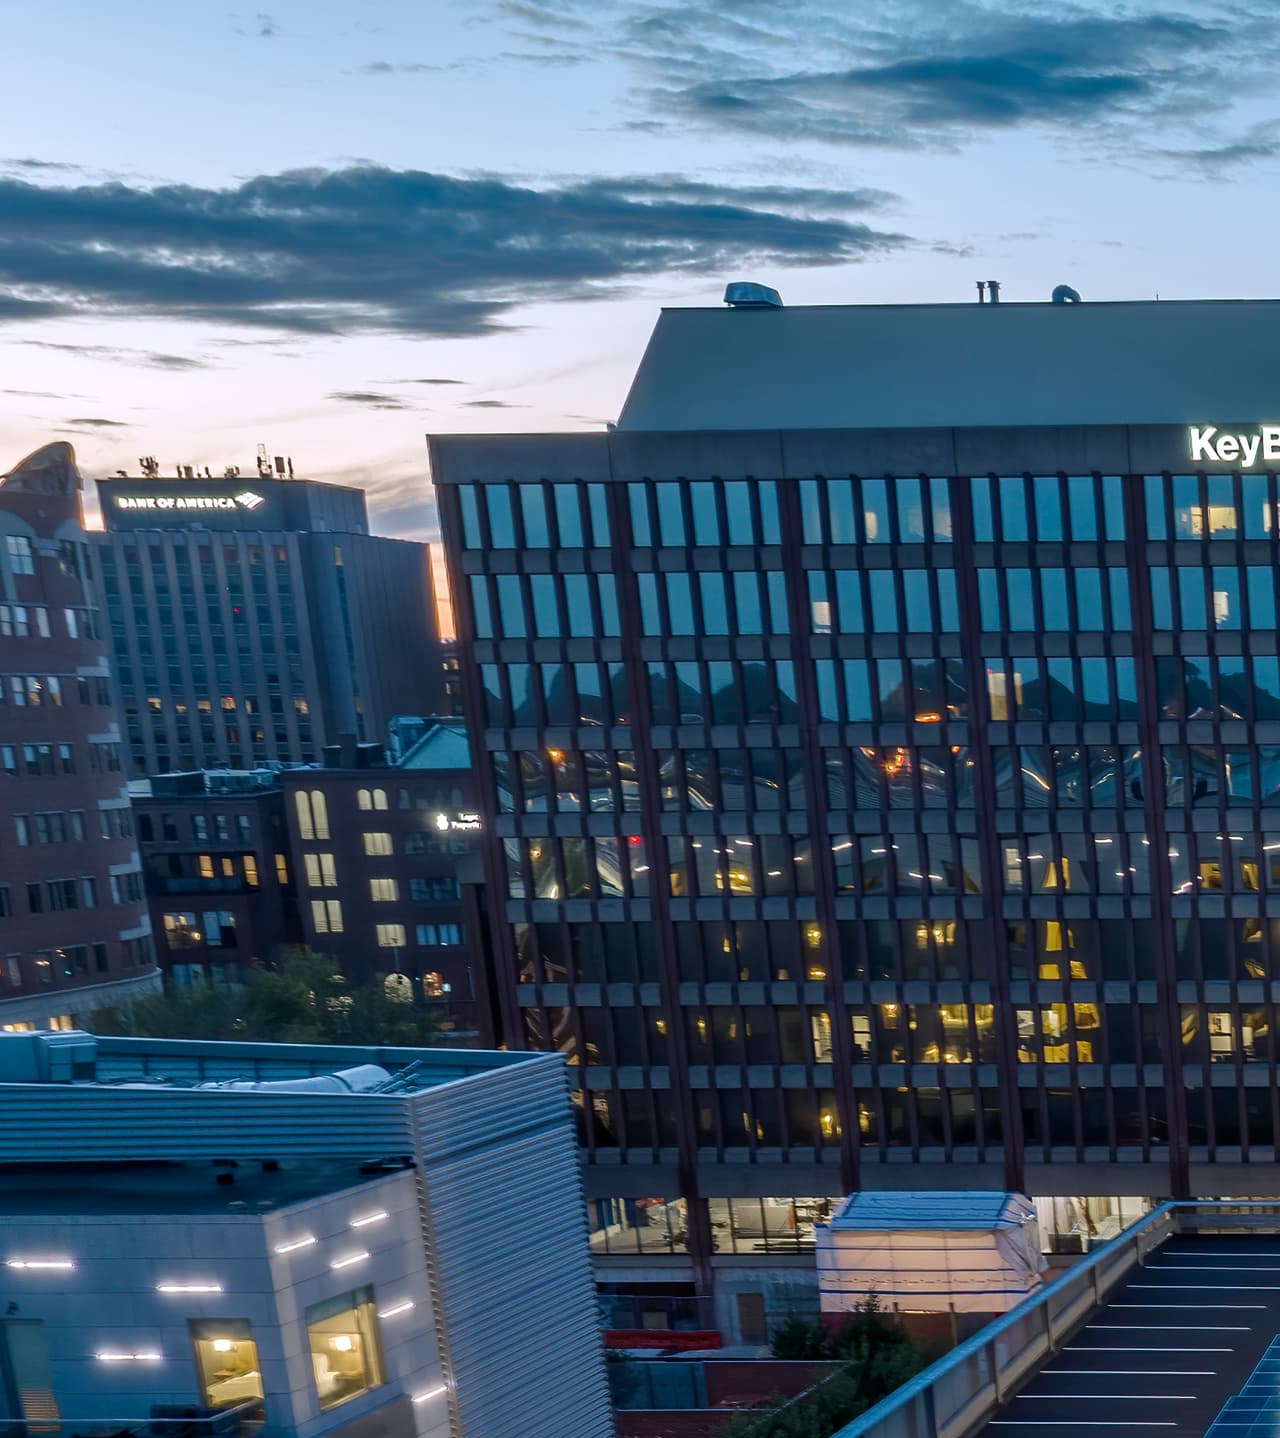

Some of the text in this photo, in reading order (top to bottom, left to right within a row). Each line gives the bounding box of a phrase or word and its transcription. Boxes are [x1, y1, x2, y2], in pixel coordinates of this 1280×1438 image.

[118, 497, 236, 508] BANK OF AMERICA
